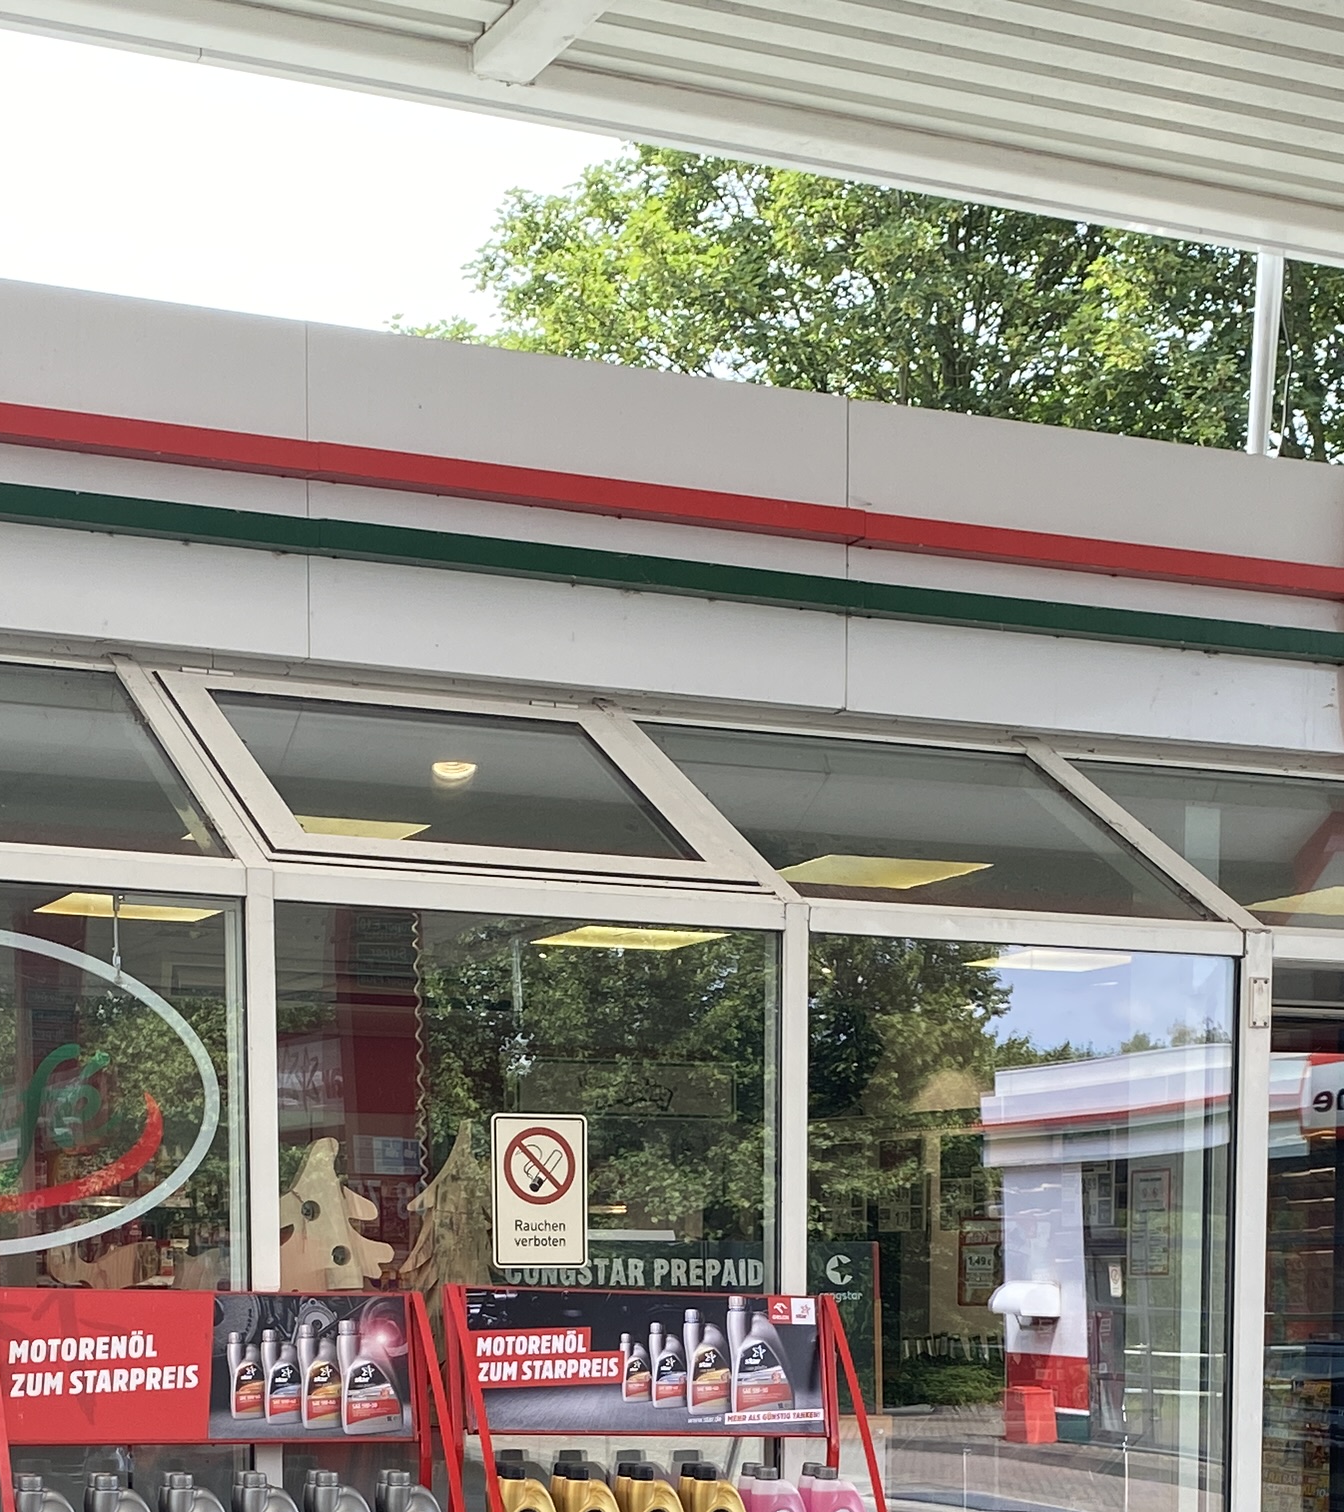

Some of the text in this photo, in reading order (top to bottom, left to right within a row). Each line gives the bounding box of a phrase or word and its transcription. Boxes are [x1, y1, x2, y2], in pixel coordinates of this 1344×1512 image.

[514, 1220, 566, 1232] Rauchen
[514, 1235, 566, 1248] verboten
[505, 1257, 764, 1287] CONGSTAR PREPAID
[819, 1290, 863, 1303] gstar
[8, 1330, 157, 1364] MOTORENÖL
[476, 1329, 587, 1357] MOTORENÖL
[478, 1357, 619, 1381] ZUM STARPREIS
[745, 1357, 761, 1365] star
[10, 1365, 199, 1398] ZUM STARPREIS
[728, 1411, 821, 1422] MEHR ALS GÜNSTIG TANKEN!
